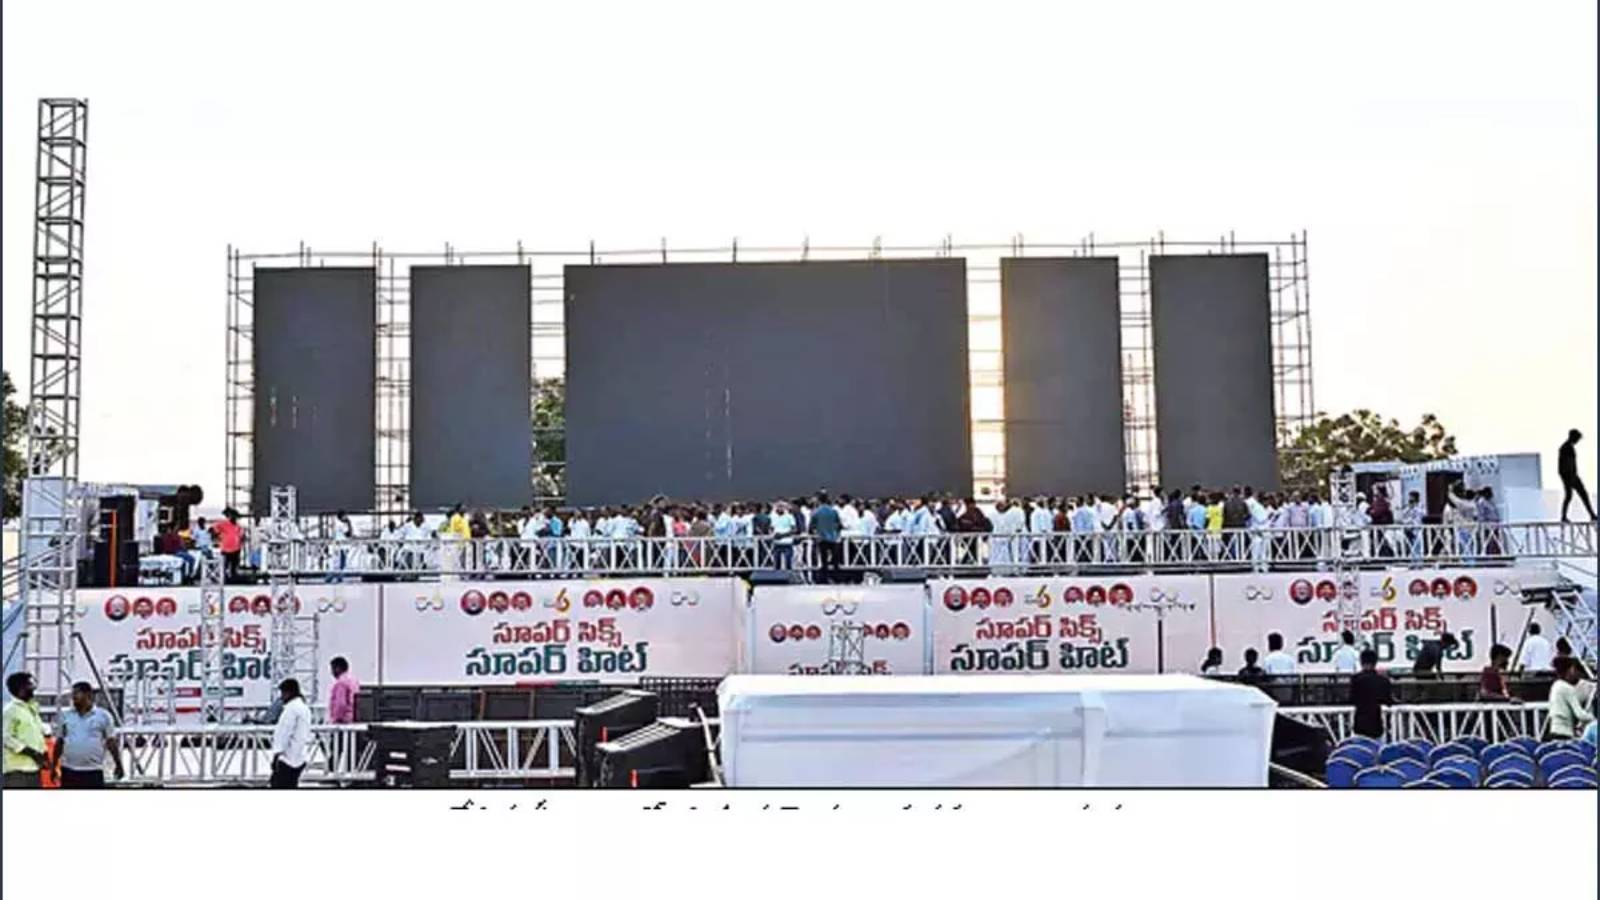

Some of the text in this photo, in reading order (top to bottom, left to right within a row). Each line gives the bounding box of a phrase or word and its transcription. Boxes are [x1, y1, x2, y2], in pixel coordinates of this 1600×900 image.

[493, 617, 622, 648] సూపర్ సిక్స్
[975, 613, 1103, 644] సూపర్ సిక్స్
[466, 641, 649, 677] సూపర్ హిట్
[951, 638, 1130, 671] సూపర్ హిట్
[1297, 632, 1394, 663] సూర్
